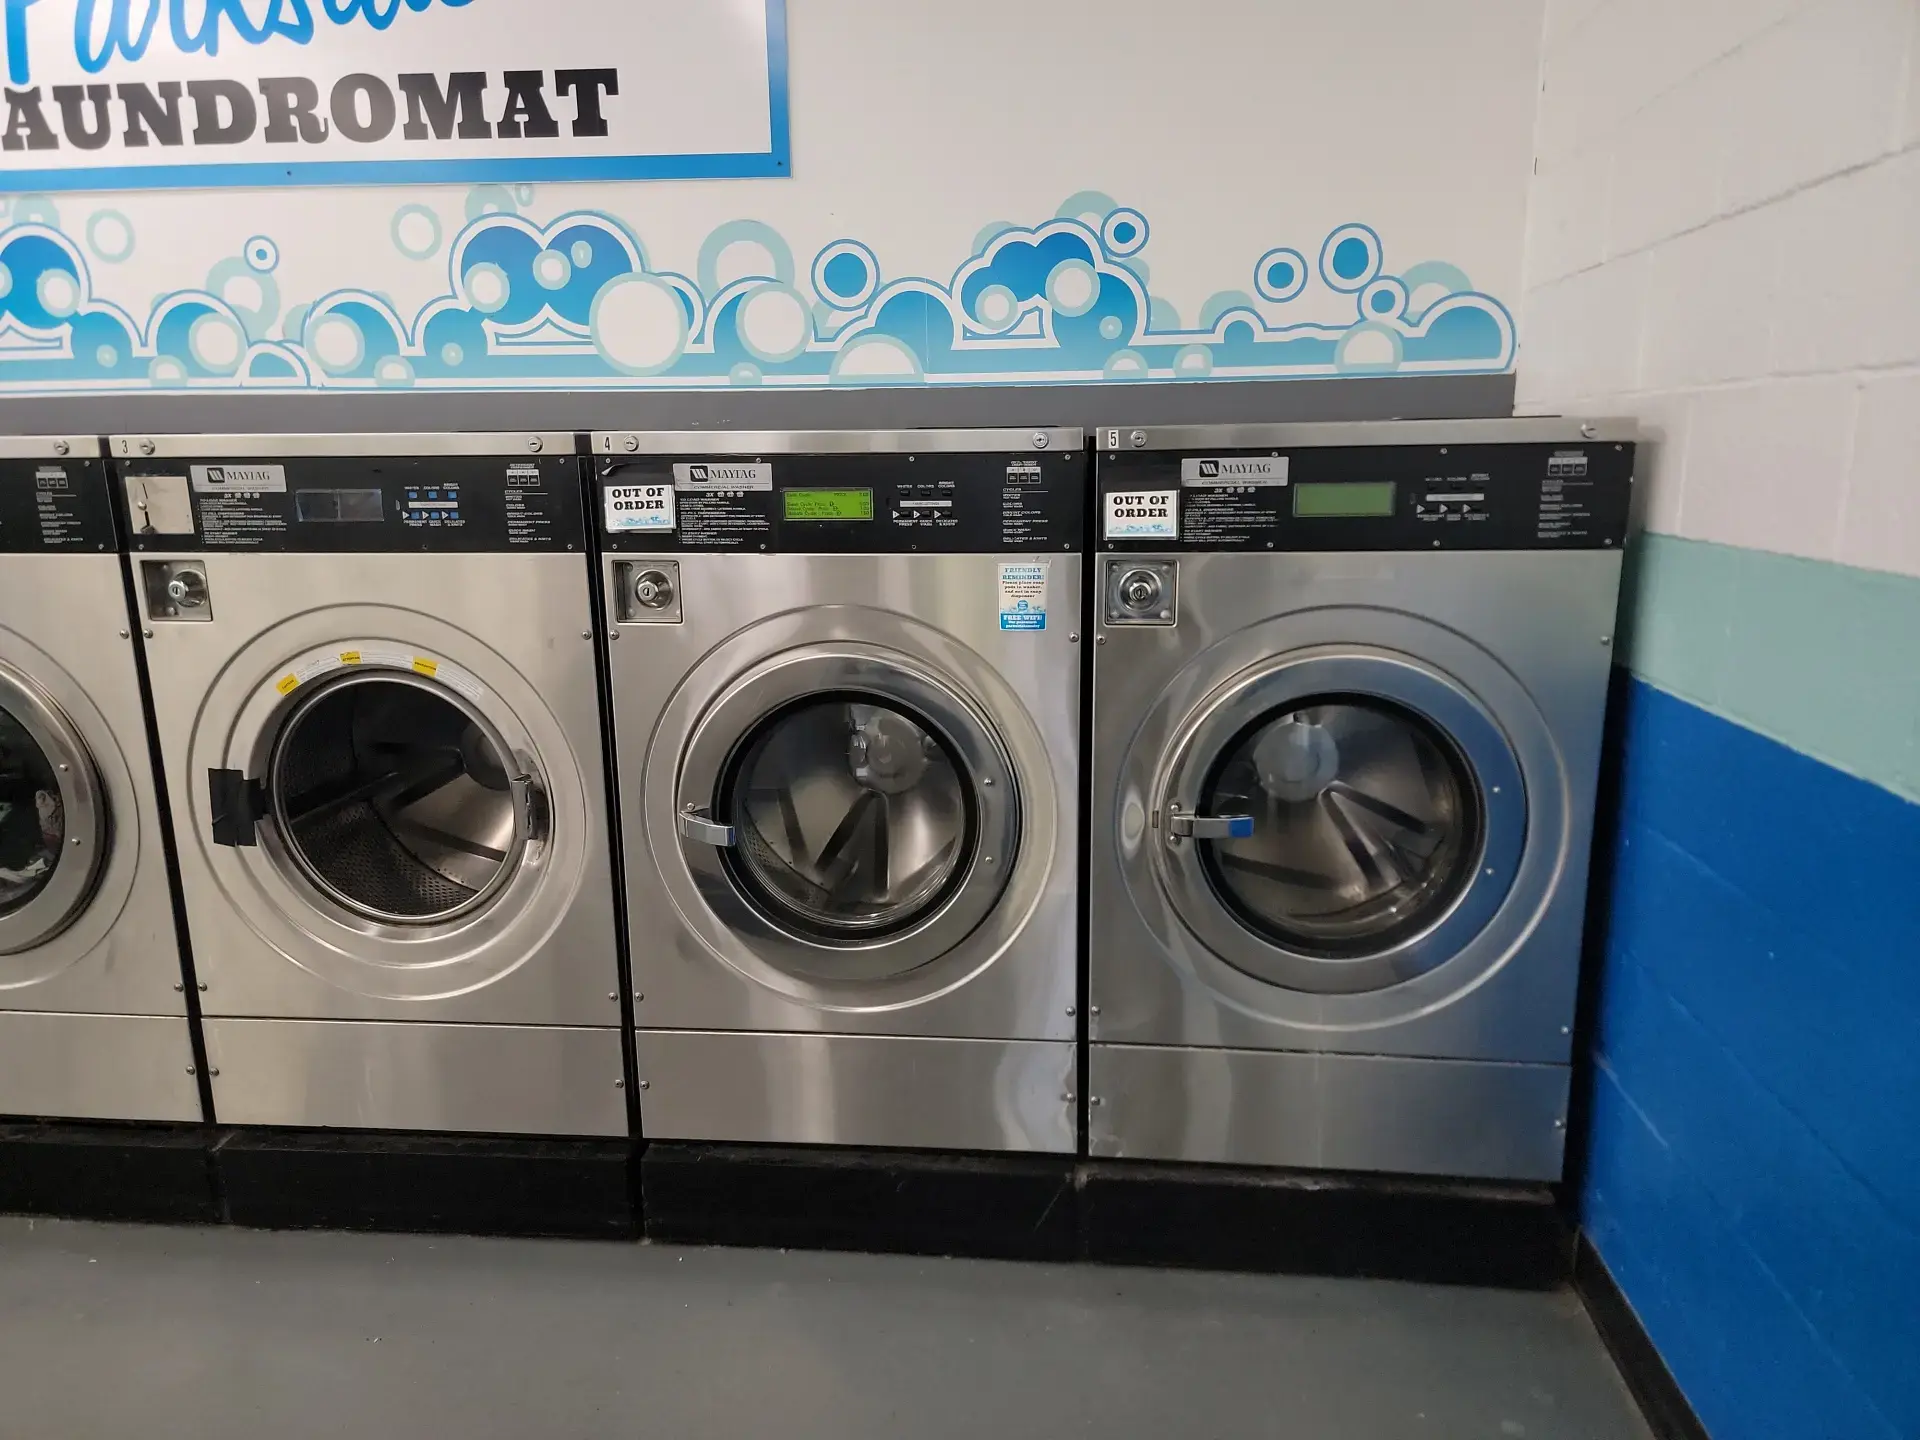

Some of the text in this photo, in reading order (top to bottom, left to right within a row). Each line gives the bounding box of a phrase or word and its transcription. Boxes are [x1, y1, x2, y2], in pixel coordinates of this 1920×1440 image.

[604, 437, 611, 450] 4
[1110, 432, 1117, 446] 5
[122, 440, 128, 454] 3
[1221, 463, 1271, 474] MAYTAG
[227, 471, 270, 481] MAYTAG
[710, 469, 756, 479] MAYTAG
[612, 487, 665, 498] OUT OF
[613, 500, 665, 510] ORDER
[1113, 496, 1169, 505] OUT OF
[1114, 508, 1169, 518] ORDER
